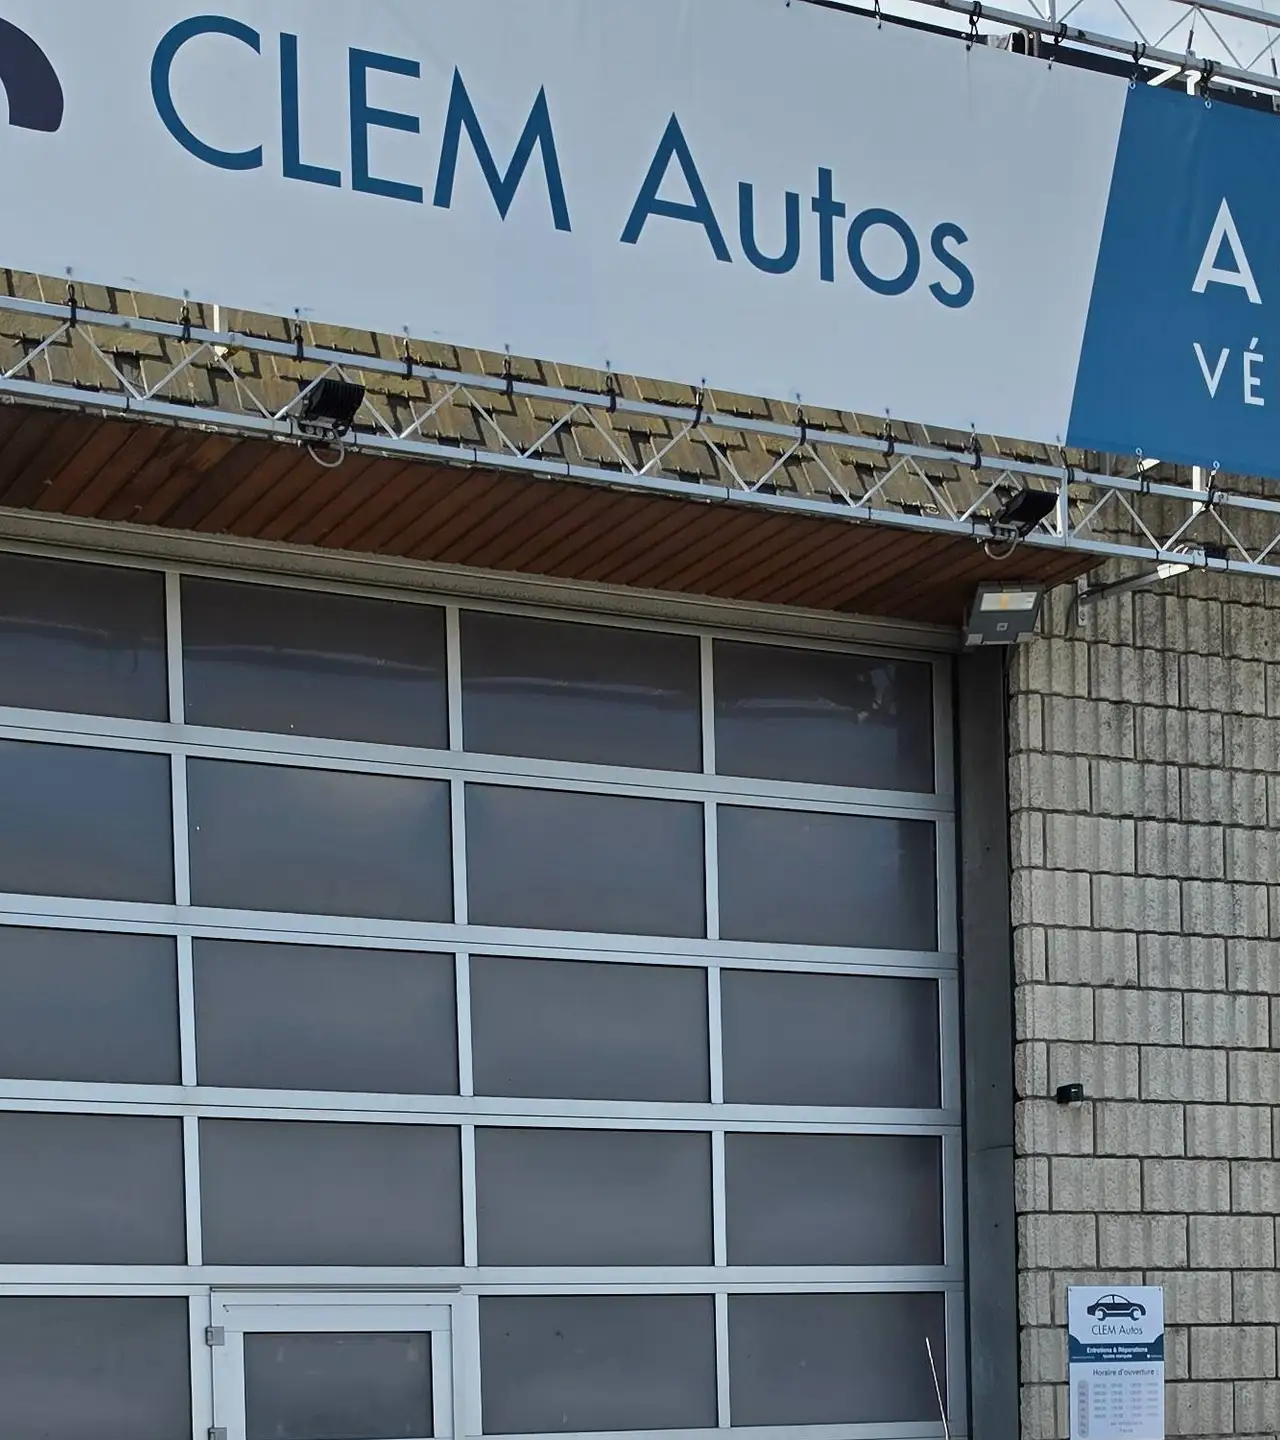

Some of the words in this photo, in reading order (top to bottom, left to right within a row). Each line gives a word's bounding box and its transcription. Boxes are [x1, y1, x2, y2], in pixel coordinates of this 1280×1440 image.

[150, 14, 572, 233] CLEM
[619, 111, 975, 310] Autos
[1091, 1325, 1116, 1335] CLEM
[1118, 1325, 1143, 1335] Autos
